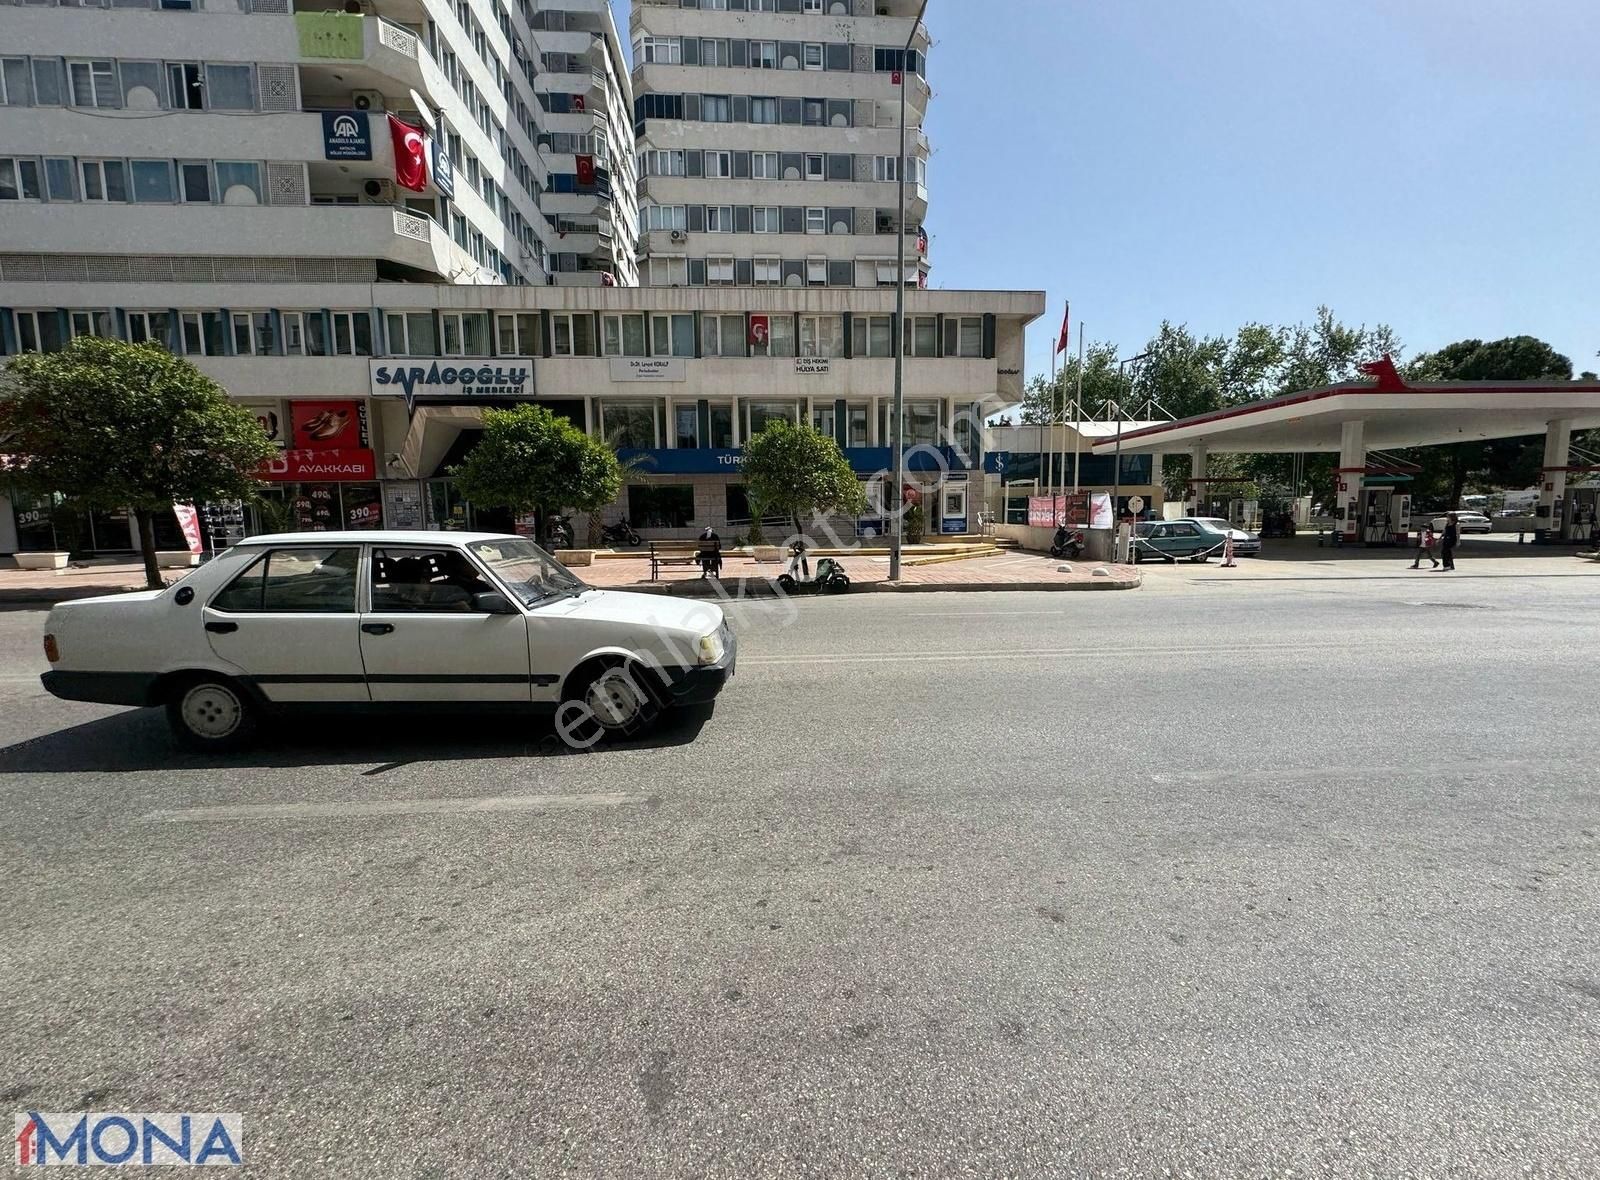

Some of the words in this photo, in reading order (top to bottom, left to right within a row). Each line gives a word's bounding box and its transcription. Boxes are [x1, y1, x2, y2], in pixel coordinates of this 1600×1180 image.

[297, 464, 366, 473] AYAKKABI
[19, 510, 40, 524] 390
[350, 506, 369, 520] 390
